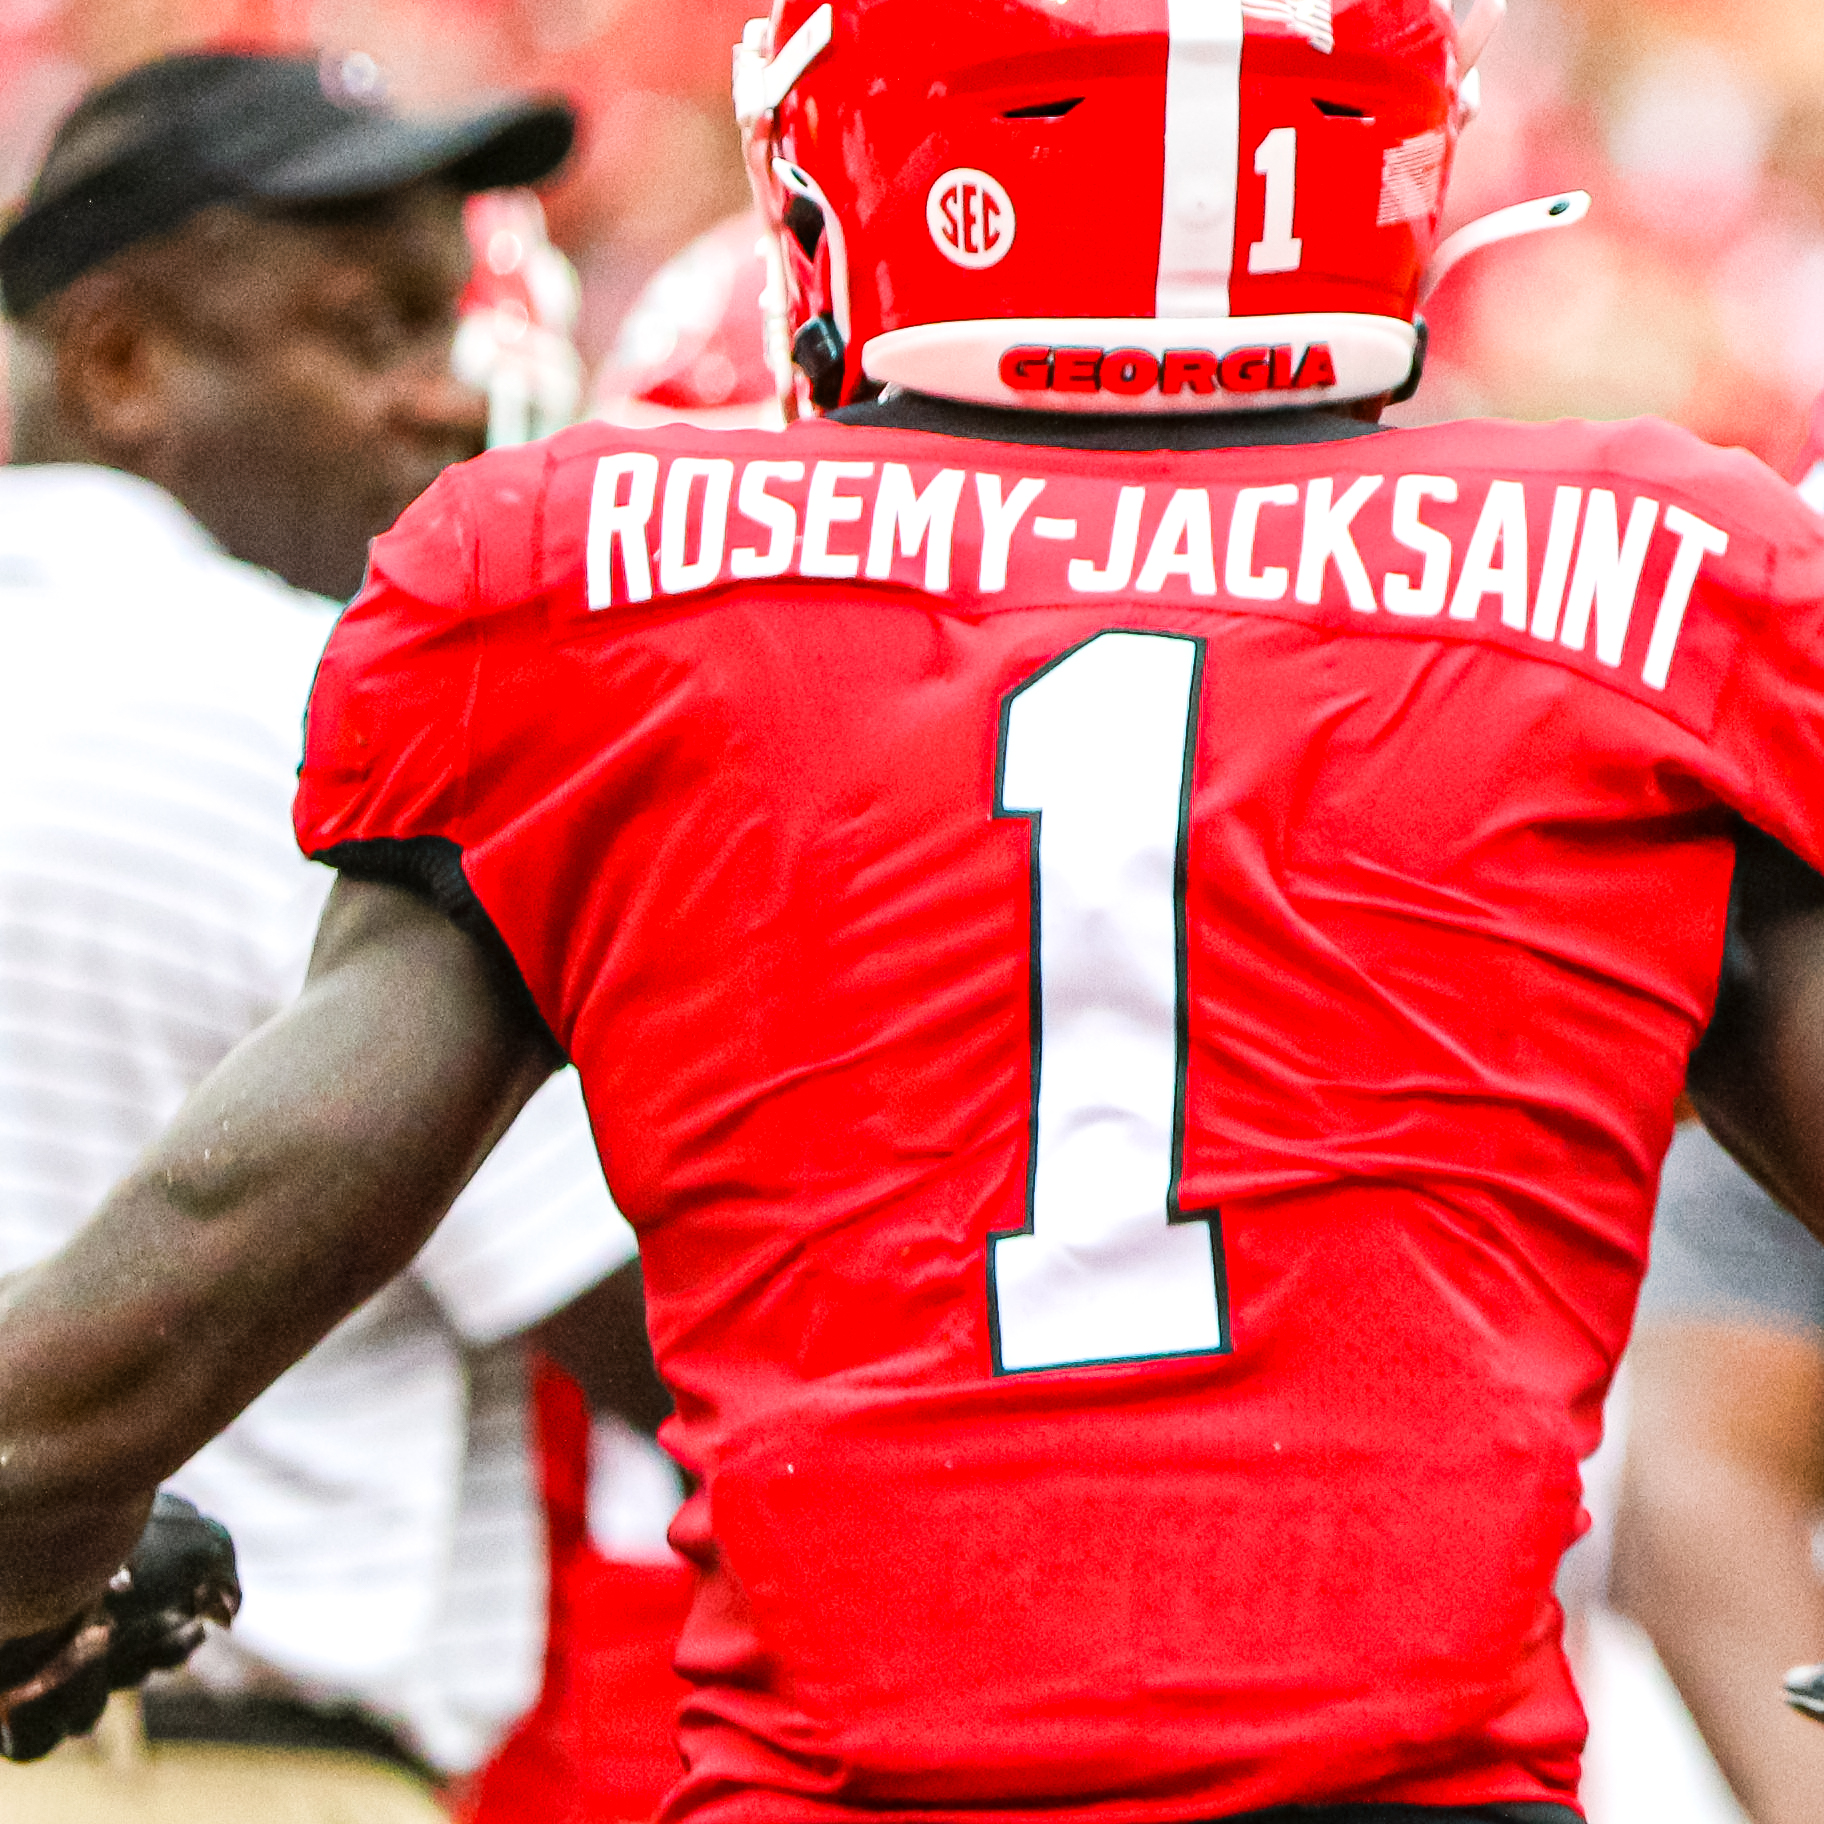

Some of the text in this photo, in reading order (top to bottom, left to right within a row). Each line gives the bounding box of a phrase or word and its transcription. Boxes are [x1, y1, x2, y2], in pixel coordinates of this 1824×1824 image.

[937, 178, 1003, 257] SEC
[1248, 127, 1302, 274] 1
[998, 341, 1337, 395] GEORGIA
[587, 452, 1729, 691] ROSEMY-JACKSAINT
[987, 629, 1231, 1377] 1
